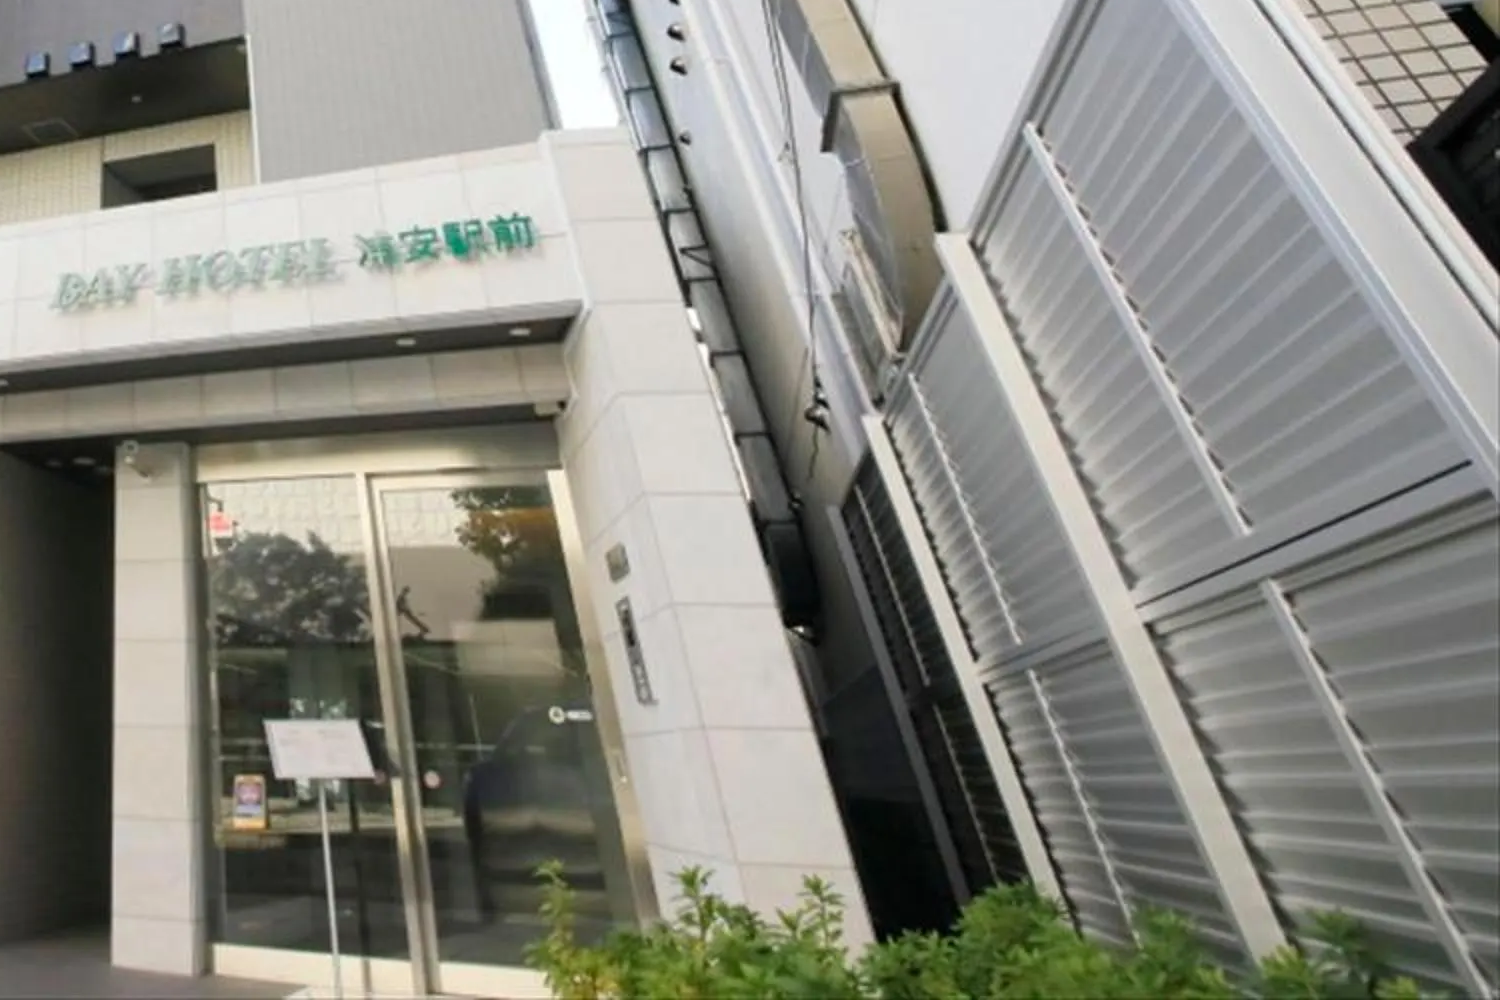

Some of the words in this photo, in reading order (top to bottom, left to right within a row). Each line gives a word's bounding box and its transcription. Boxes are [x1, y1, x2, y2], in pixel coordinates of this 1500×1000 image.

[52, 261, 148, 311] BAY
[157, 238, 343, 297] HOTEL
[354, 212, 536, 266] 浦安駅前
